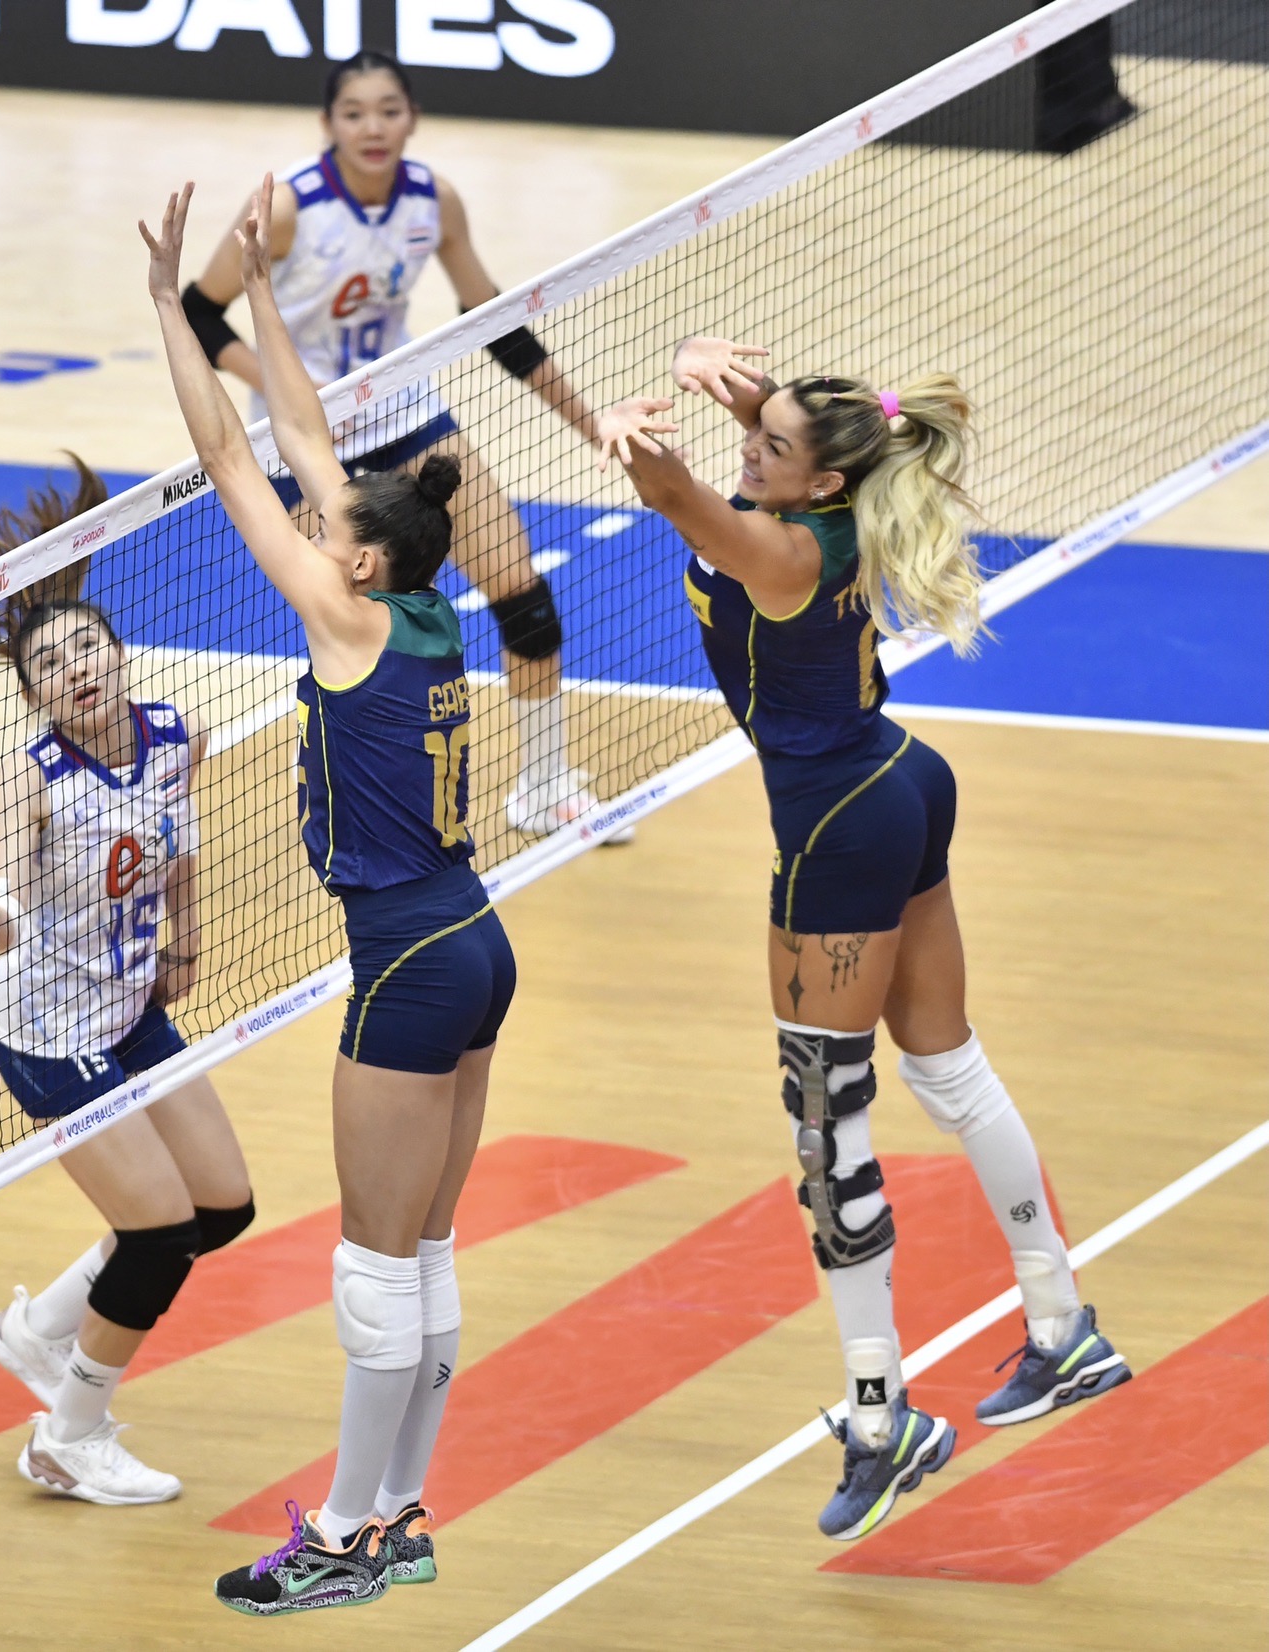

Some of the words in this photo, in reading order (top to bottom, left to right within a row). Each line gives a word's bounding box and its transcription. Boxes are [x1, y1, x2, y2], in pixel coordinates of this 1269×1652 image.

[162, 471, 207, 509] MIKASA
[246, 1000, 295, 1034] VOLLEYBALL
[66, 1103, 115, 1138] VOLLEYBALL
